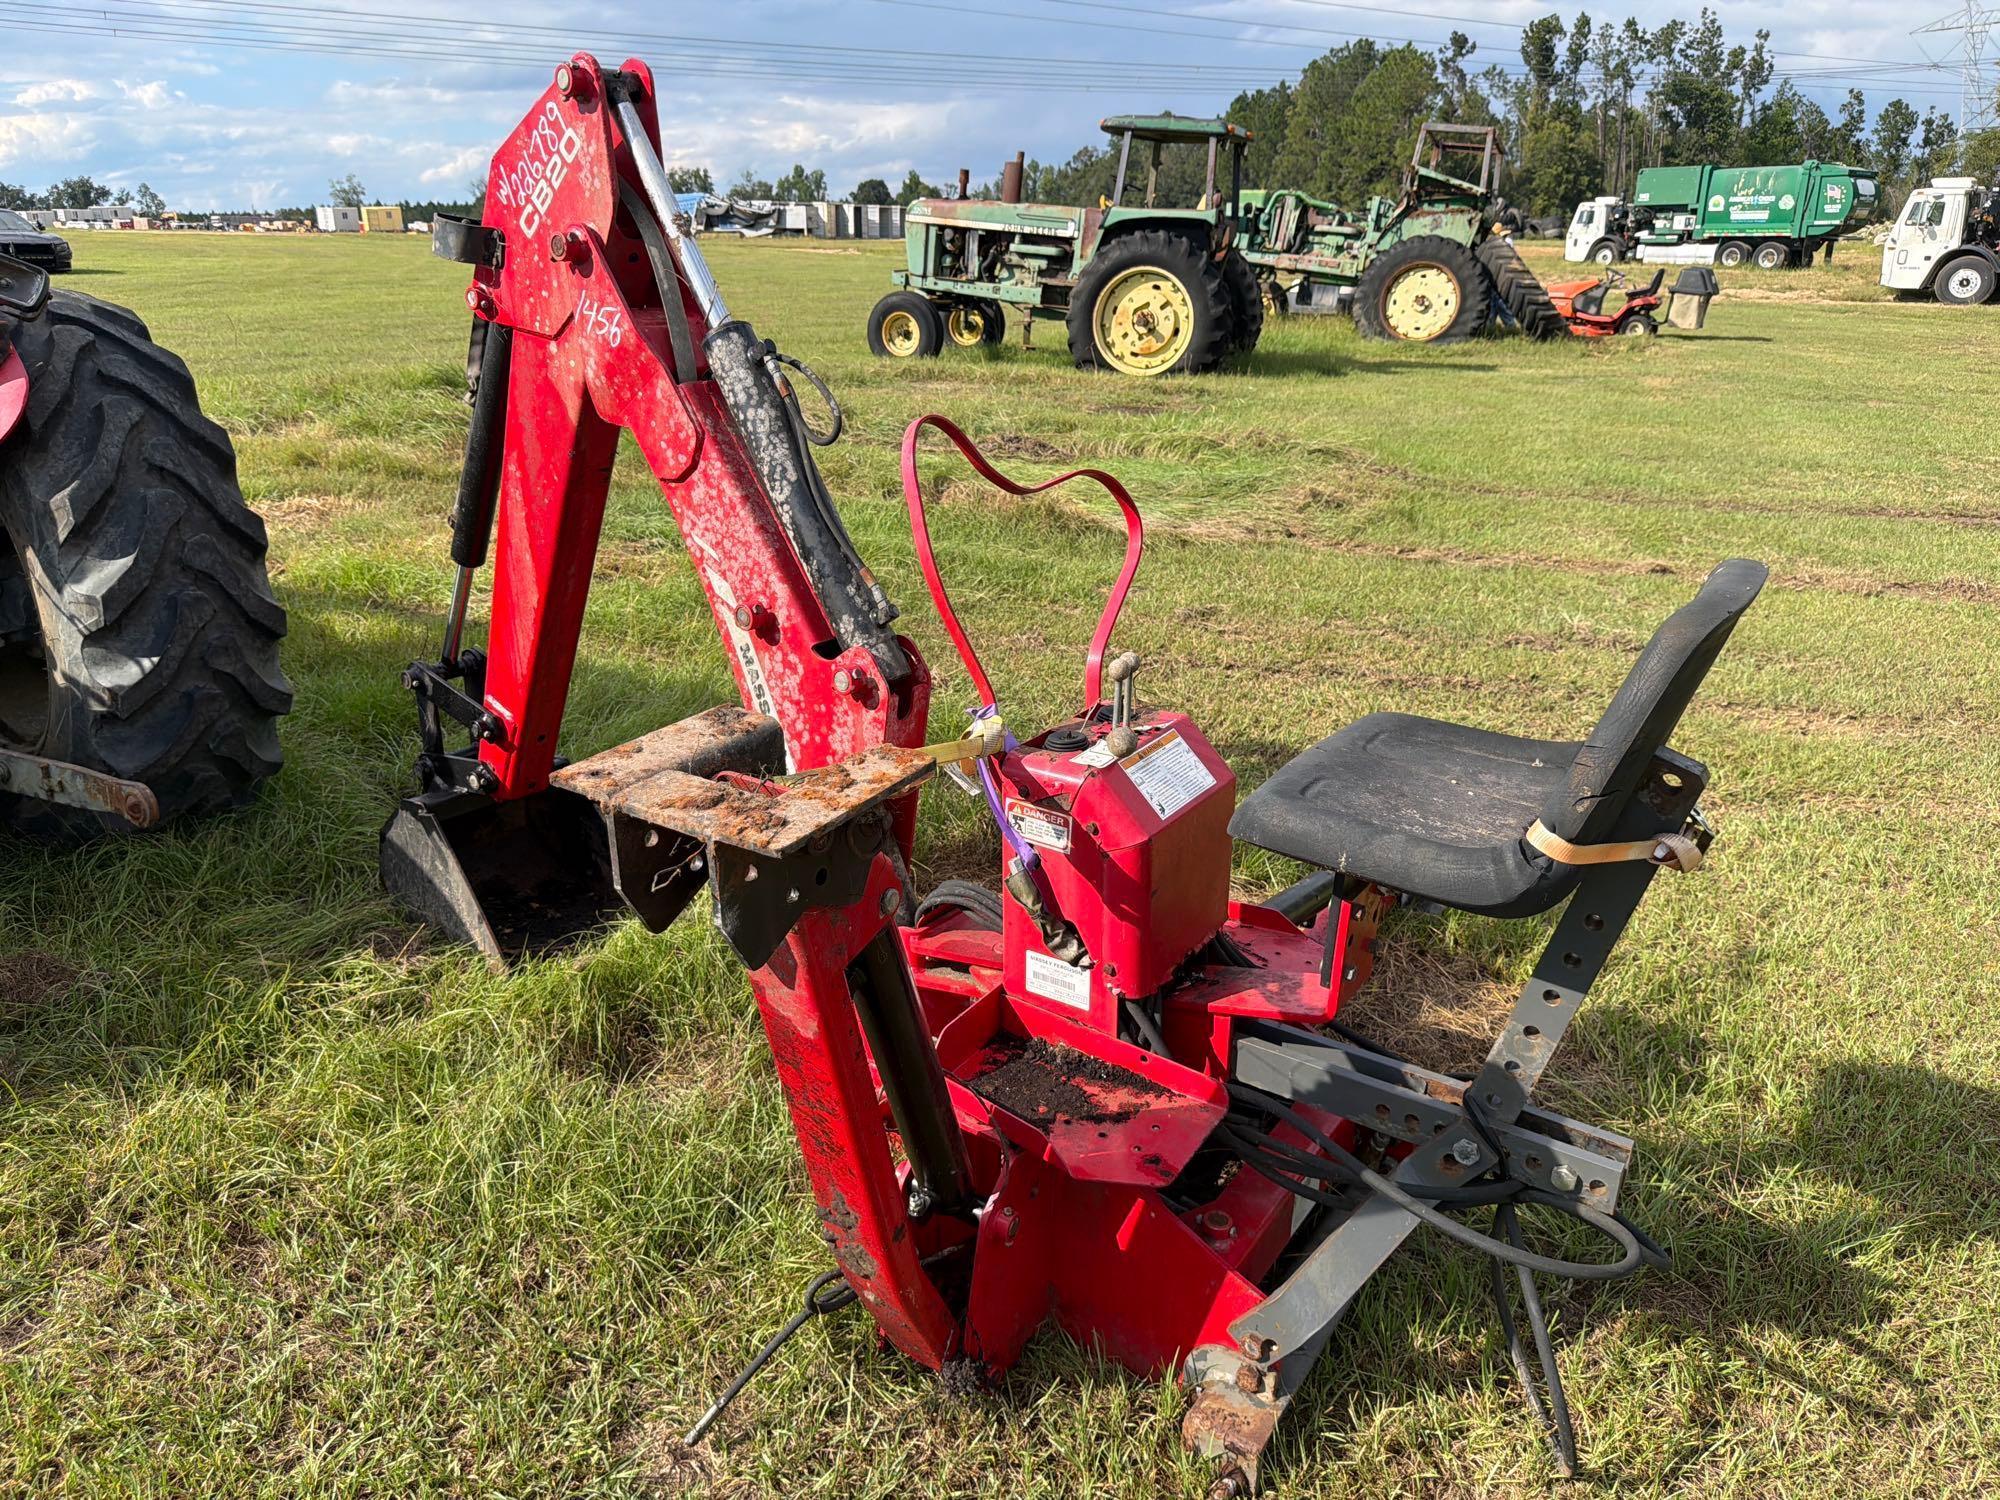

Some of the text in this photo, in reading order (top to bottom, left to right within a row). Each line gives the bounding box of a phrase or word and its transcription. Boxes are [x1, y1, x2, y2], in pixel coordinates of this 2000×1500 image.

[519, 127, 580, 239] CB20
[575, 289, 622, 348] 1456
[1023, 807, 1064, 826] DANGER
